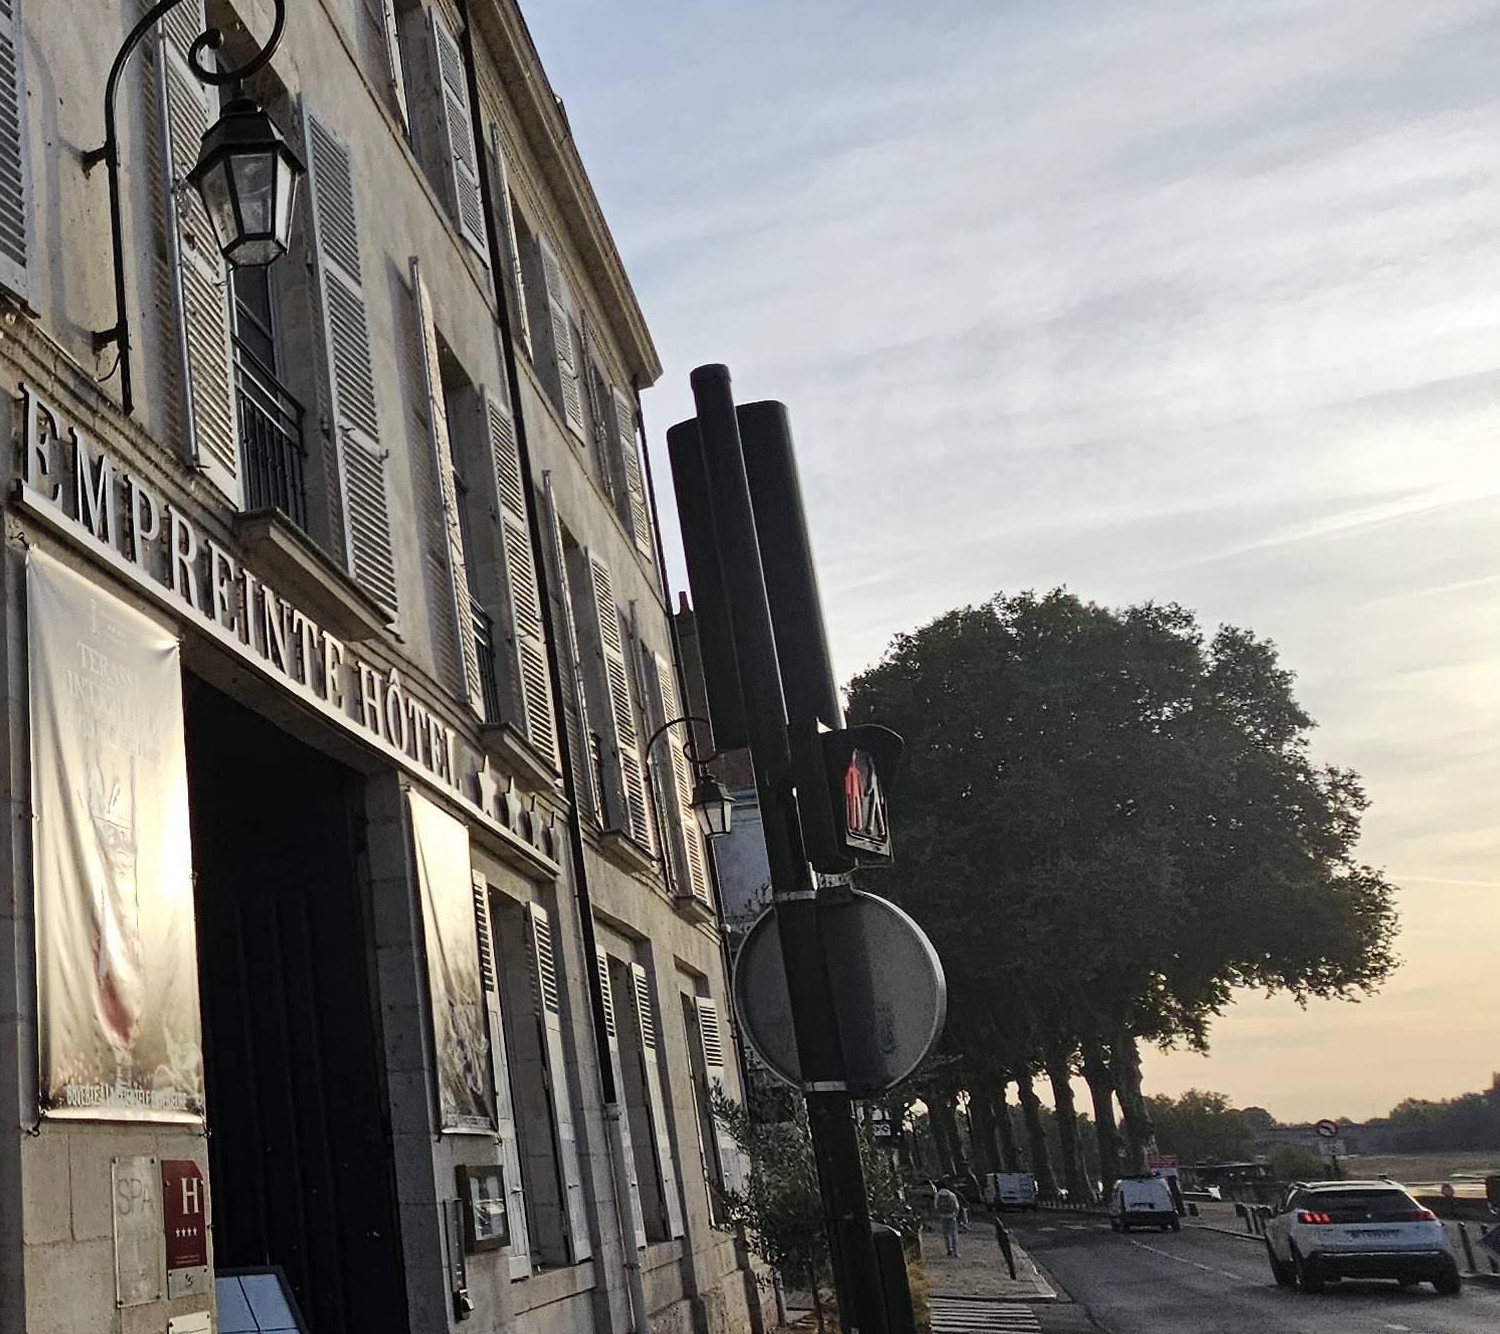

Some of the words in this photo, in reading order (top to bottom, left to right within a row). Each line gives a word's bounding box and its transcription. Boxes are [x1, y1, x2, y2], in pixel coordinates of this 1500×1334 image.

[20, 382, 346, 716] EMPREINTE
[357, 660, 464, 794] HÔTEL
[119, 1178, 154, 1215] SPA
[181, 1177, 200, 1215] H
